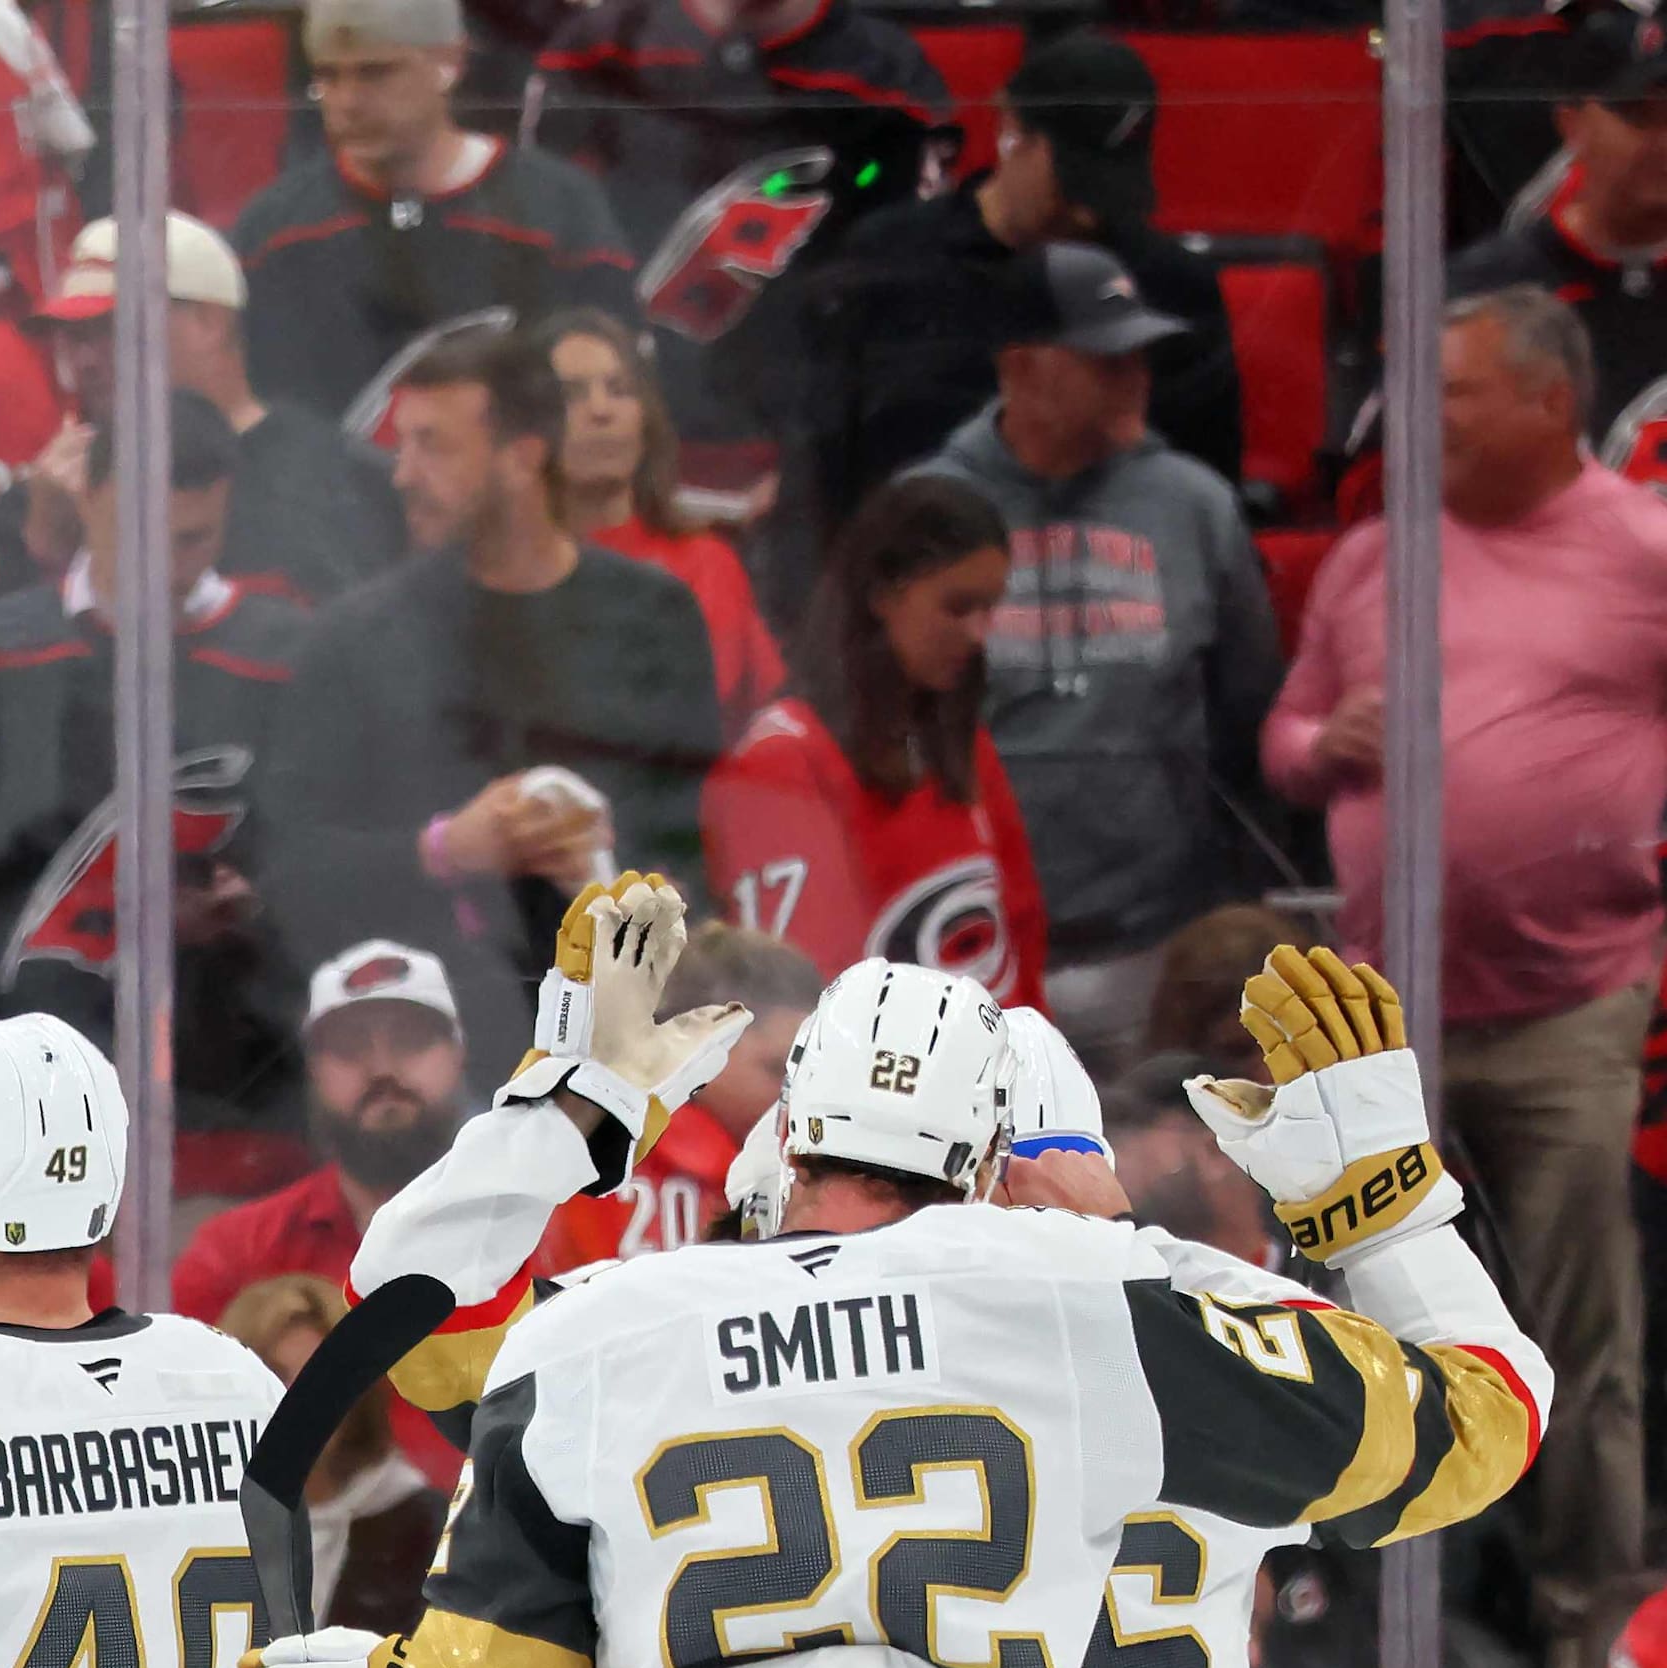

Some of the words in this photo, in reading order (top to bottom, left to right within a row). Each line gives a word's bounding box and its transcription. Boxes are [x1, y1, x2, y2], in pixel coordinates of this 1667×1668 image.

[870, 1050, 920, 1094] 22
[44, 1146, 88, 1182] 49
[1285, 1144, 1430, 1250] BAUE
[617, 1177, 700, 1262] 20
[717, 1295, 925, 1394] SMITH
